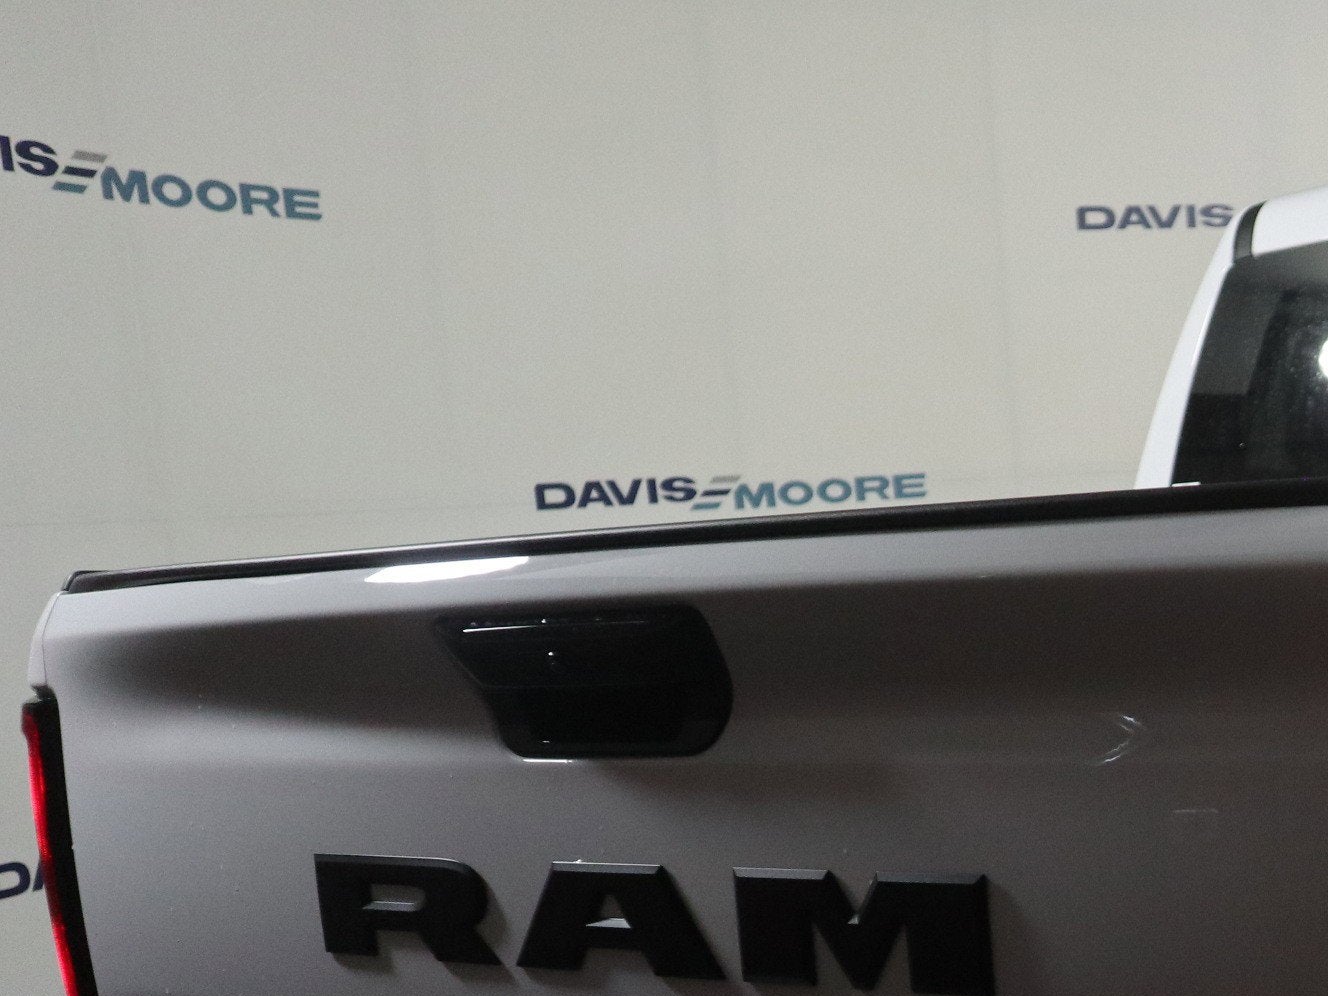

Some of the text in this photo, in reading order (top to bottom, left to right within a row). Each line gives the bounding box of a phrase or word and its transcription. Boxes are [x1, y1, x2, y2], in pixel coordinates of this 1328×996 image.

[100, 165, 323, 221] MOORE
[1075, 203, 1234, 230] DAVIS
[534, 472, 929, 511] DAVIS MOORE
